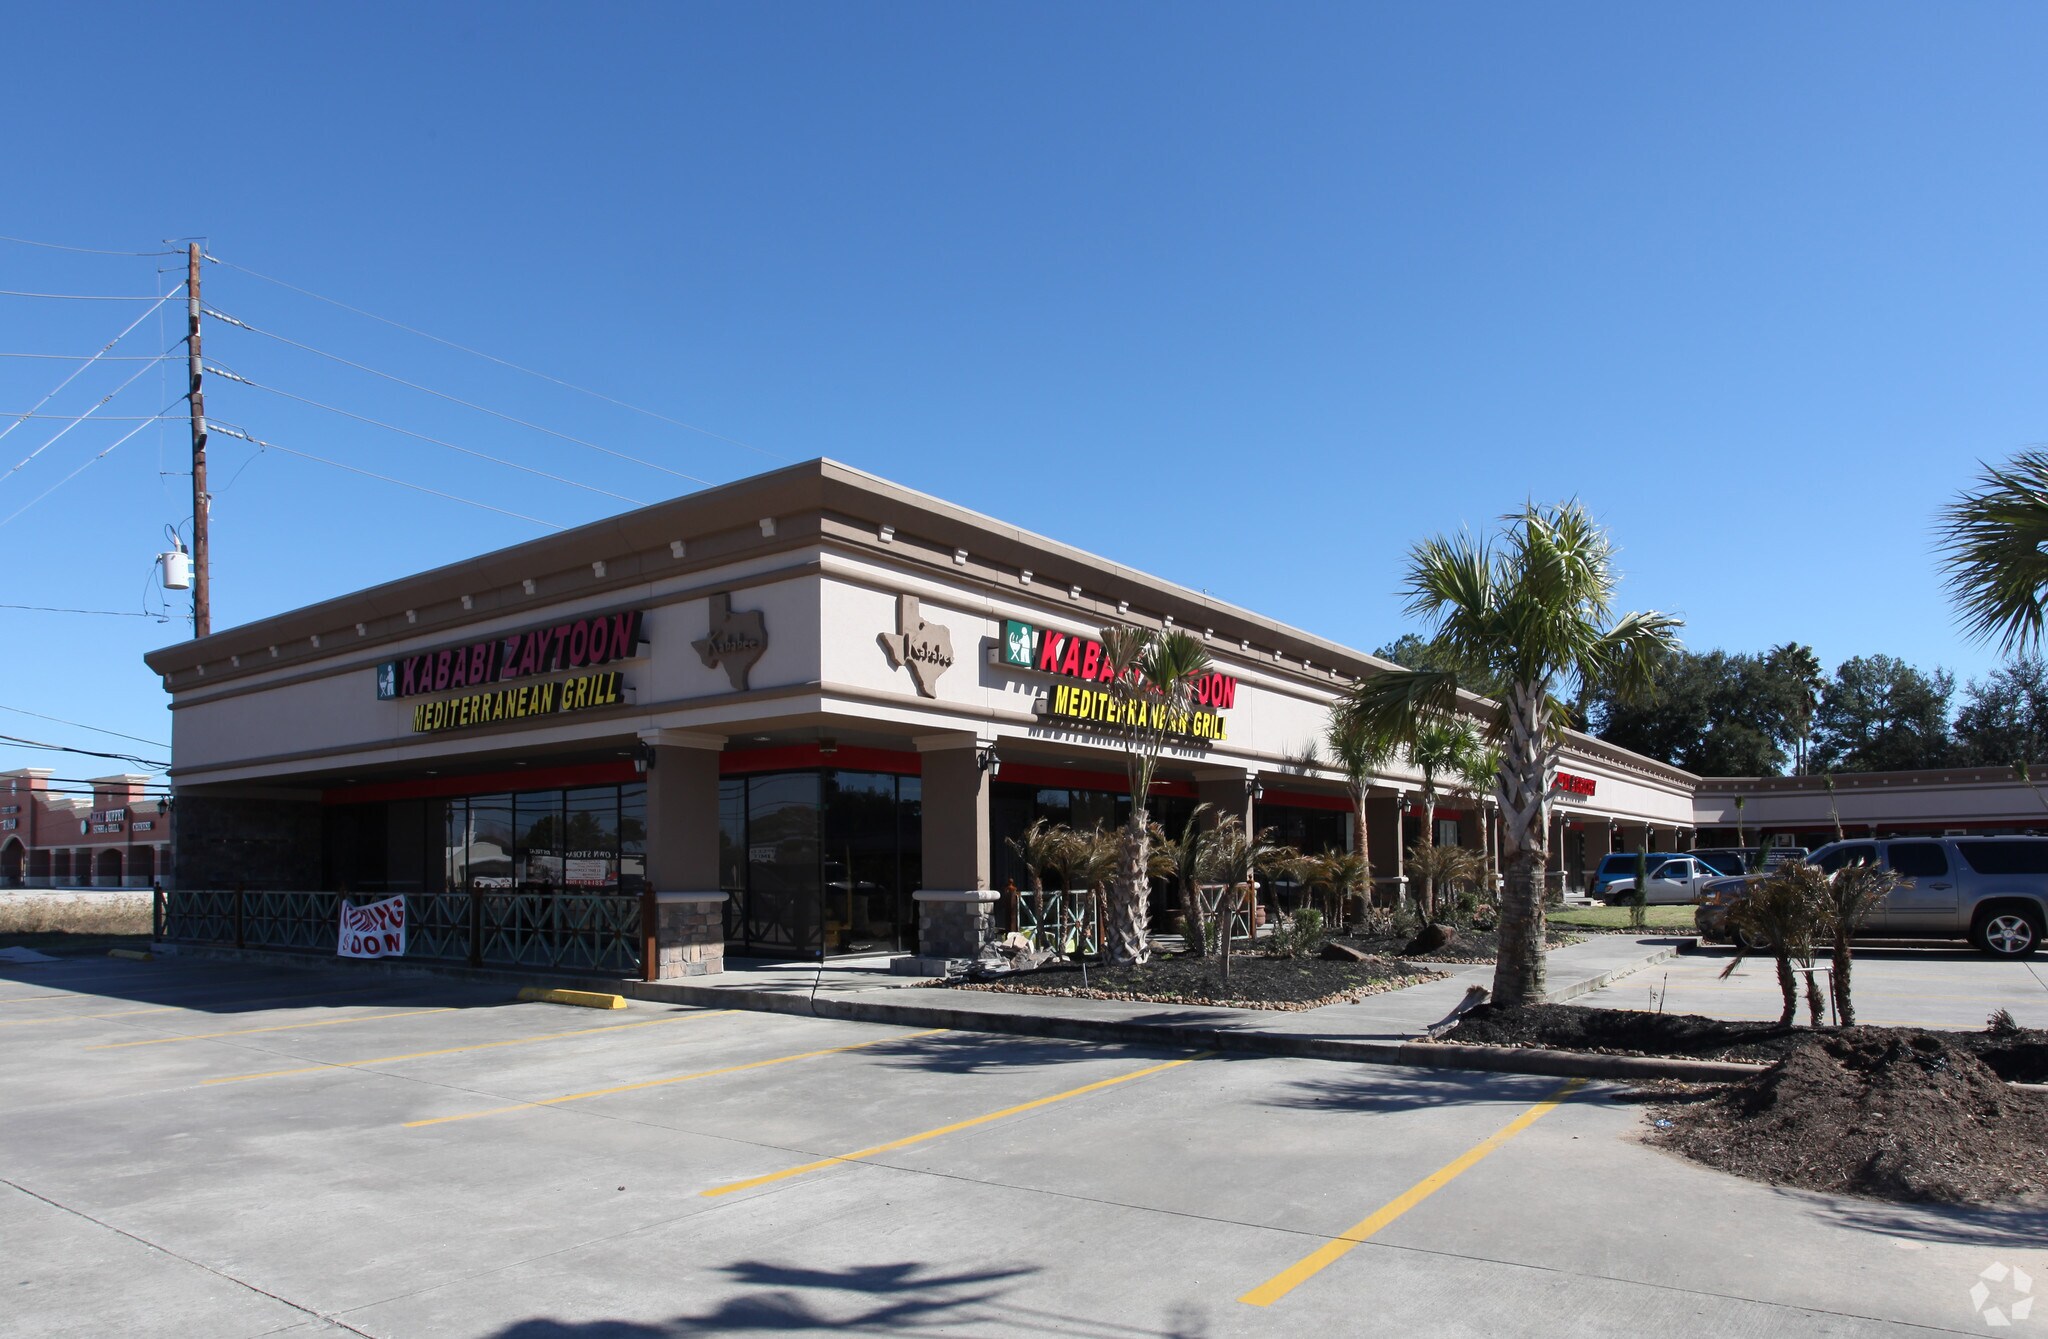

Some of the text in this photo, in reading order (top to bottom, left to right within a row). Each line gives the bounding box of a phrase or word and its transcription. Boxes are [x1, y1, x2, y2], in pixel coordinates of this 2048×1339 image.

[401, 610, 639, 695] KABABI ZAYTOON
[412, 671, 619, 732] MEDITERRANEAN GRILL
[1192, 711, 1228, 740] GRILL
[105, 809, 124, 822] BUFFET
[108, 823, 120, 833] GRILL
[343, 933, 401, 954] SOON
